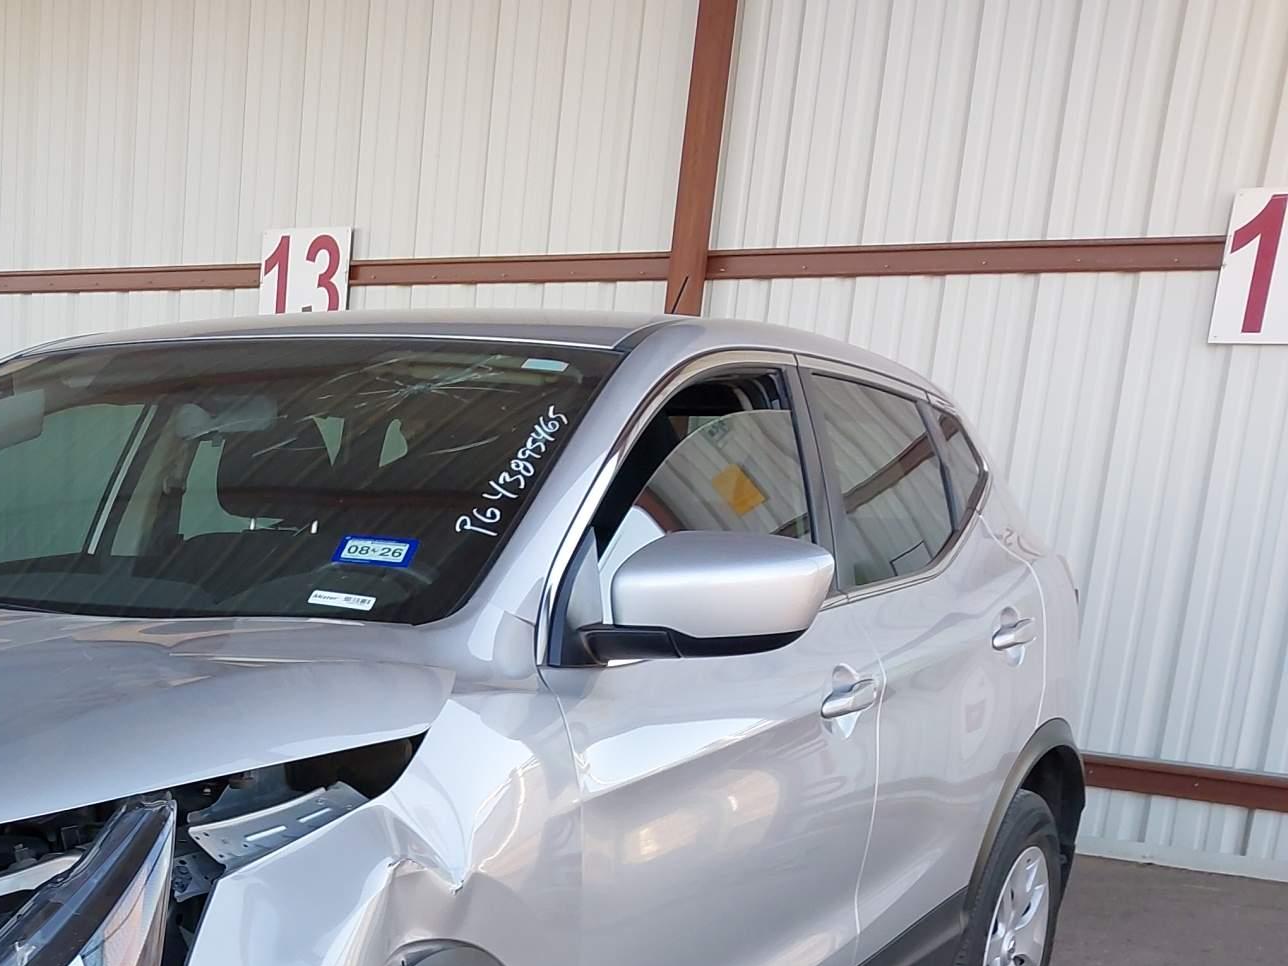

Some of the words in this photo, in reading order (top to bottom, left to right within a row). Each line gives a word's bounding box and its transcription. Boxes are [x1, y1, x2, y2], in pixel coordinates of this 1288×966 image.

[264, 234, 340, 314] 13
[481, 405, 568, 499] 43895465
[347, 544, 371, 555] 08
[379, 547, 404, 558] 26
